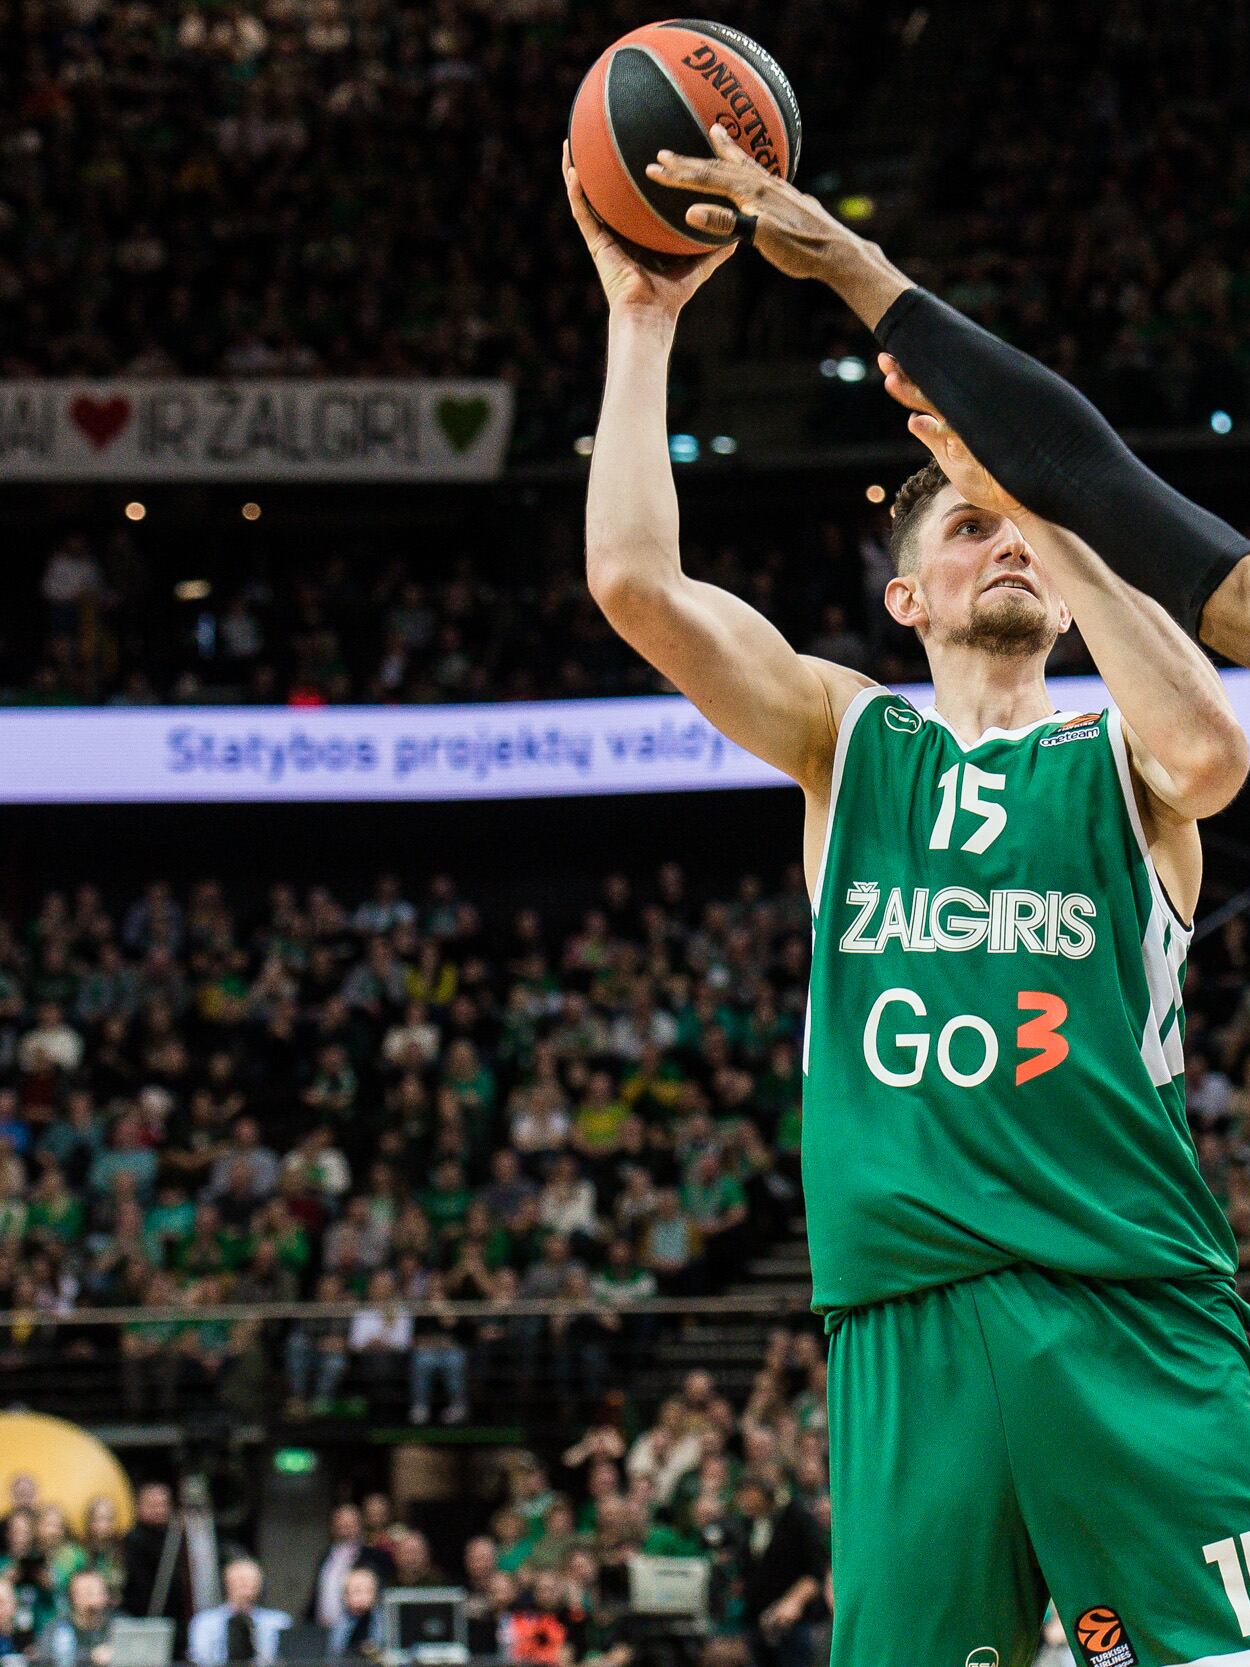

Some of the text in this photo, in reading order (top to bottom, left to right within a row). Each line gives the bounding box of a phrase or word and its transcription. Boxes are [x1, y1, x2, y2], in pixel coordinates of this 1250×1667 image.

[165, 722, 377, 783] Statybos
[394, 723, 592, 782] projektų
[1041, 728, 1099, 746] oneteam
[929, 762, 1007, 855] 15
[839, 882, 1096, 959] ŽALGIRIS
[1090, 1643, 1129, 1664] TURKISH
